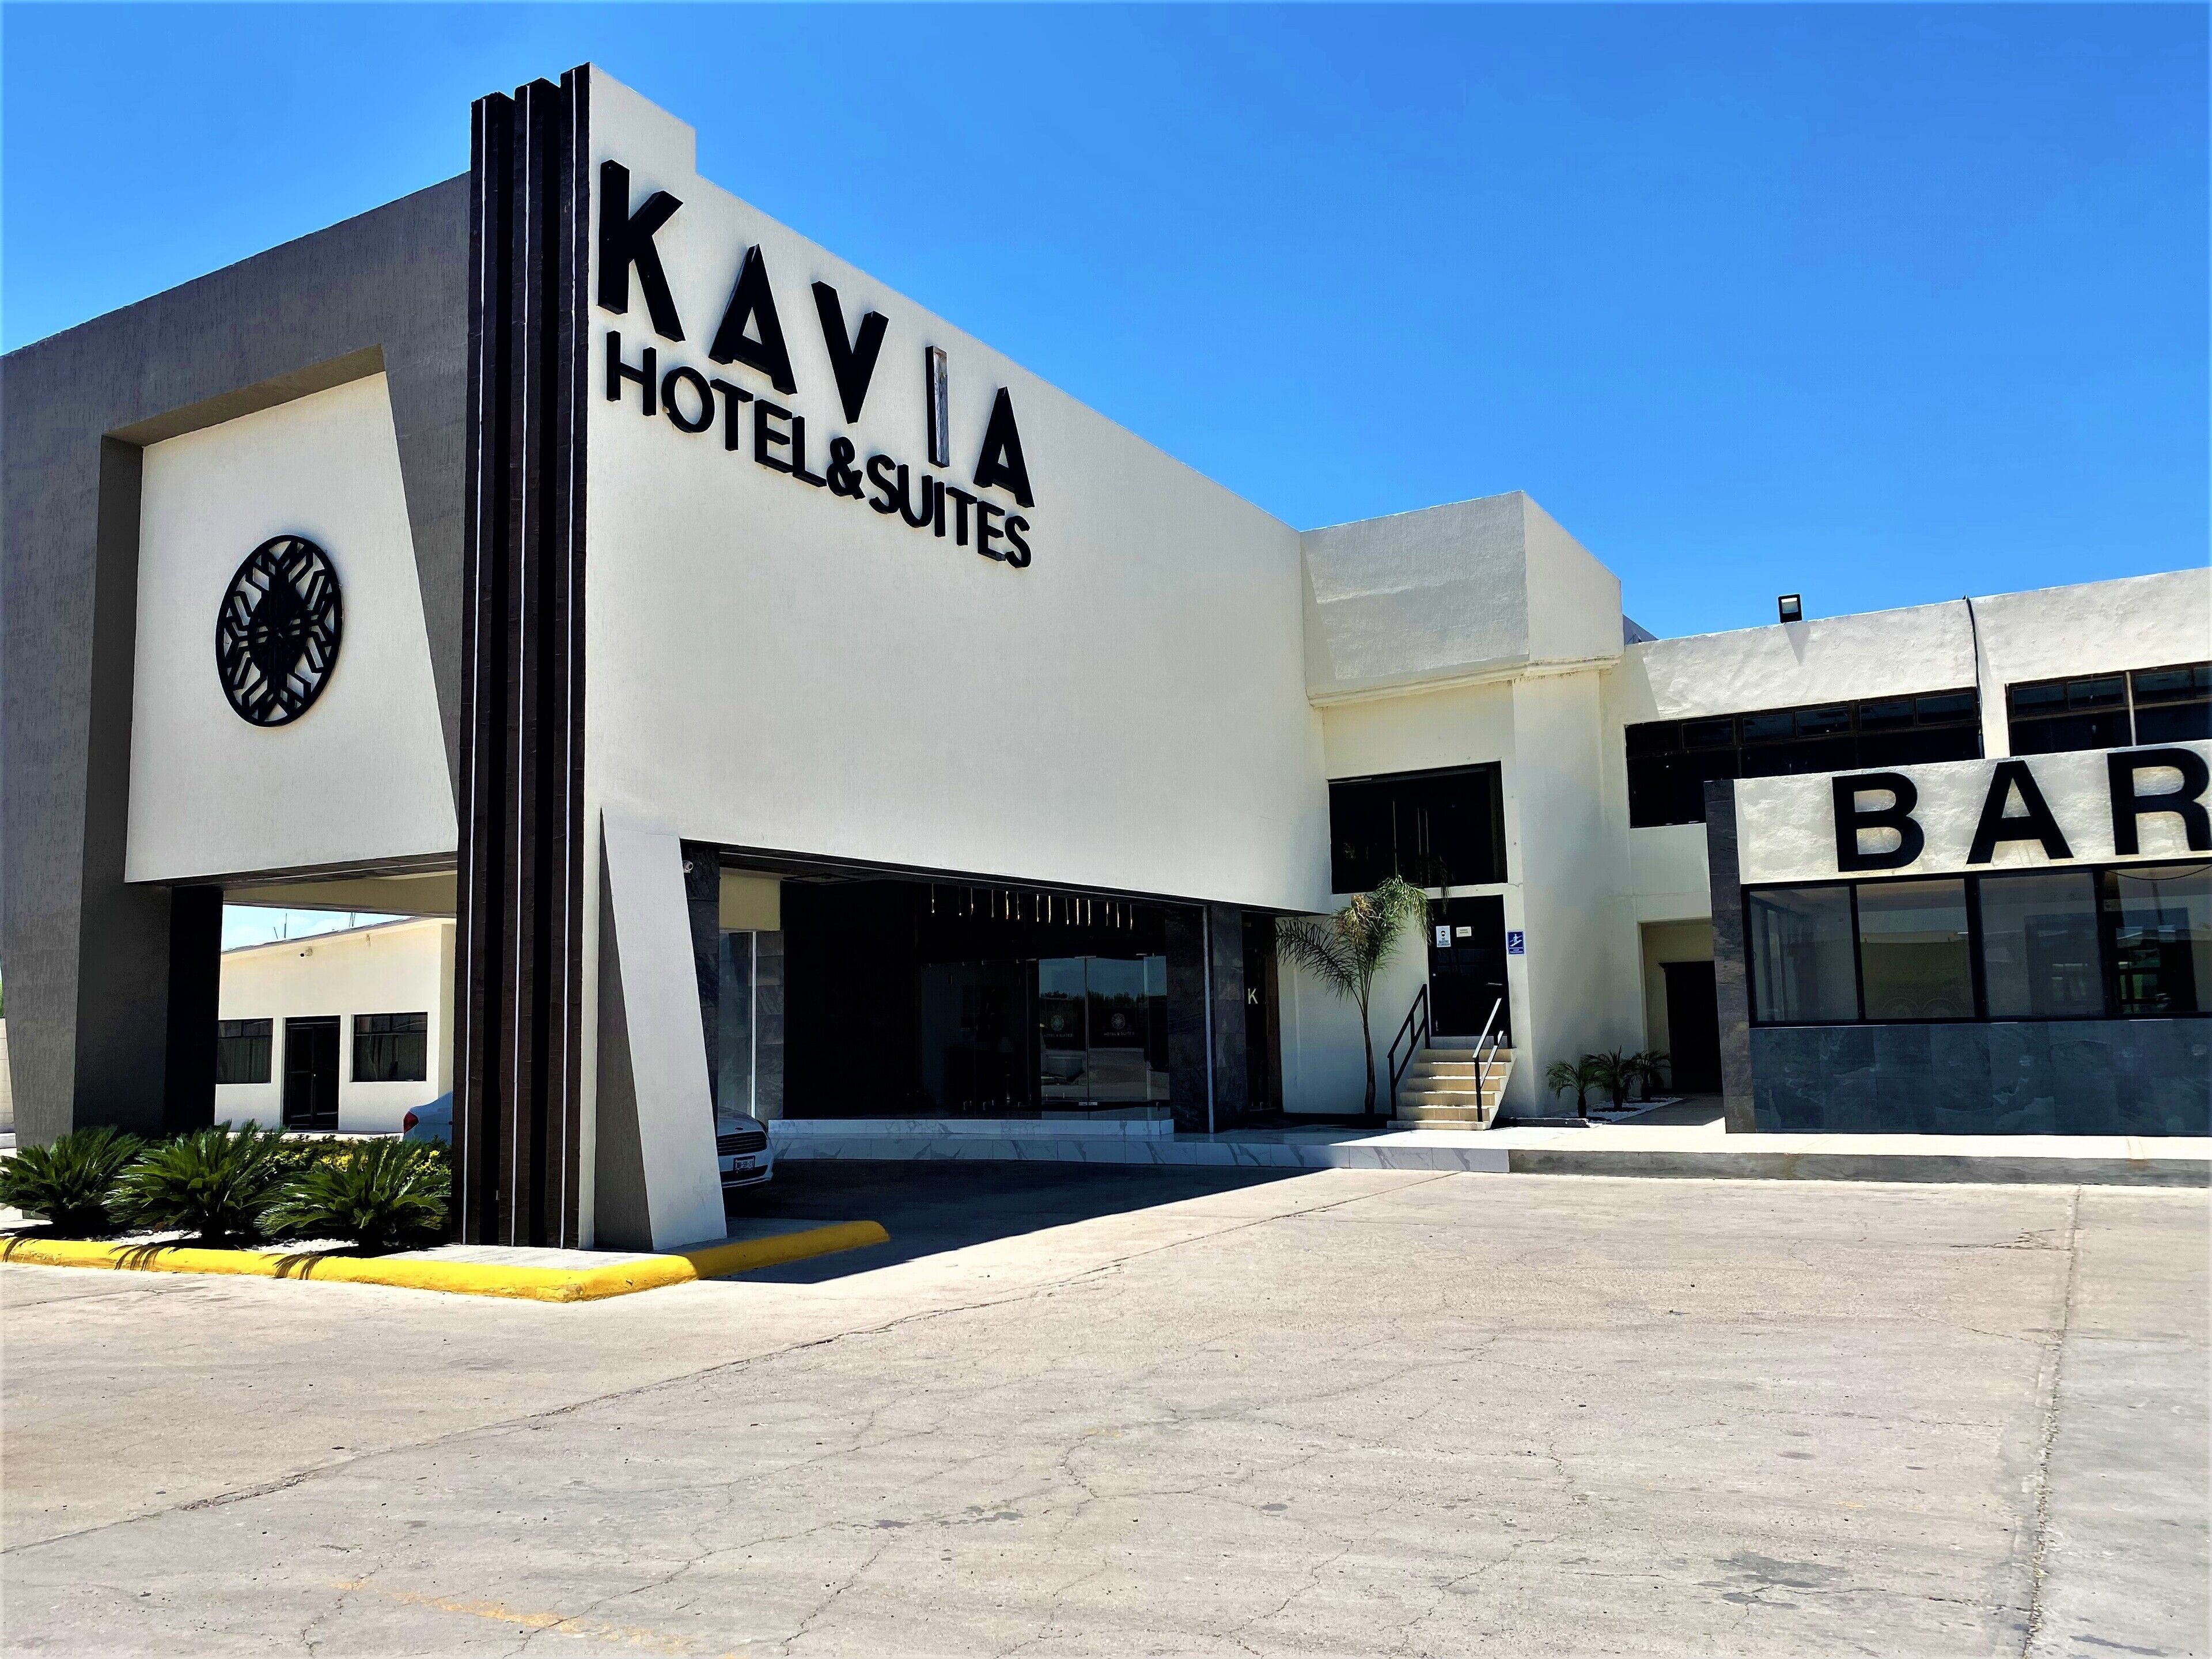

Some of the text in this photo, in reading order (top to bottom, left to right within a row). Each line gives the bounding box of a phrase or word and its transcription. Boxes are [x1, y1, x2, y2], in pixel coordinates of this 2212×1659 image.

[597, 160, 1035, 508] KAVIA
[1832, 748, 2212, 873] BAR
[1248, 988, 1259, 1005] K
